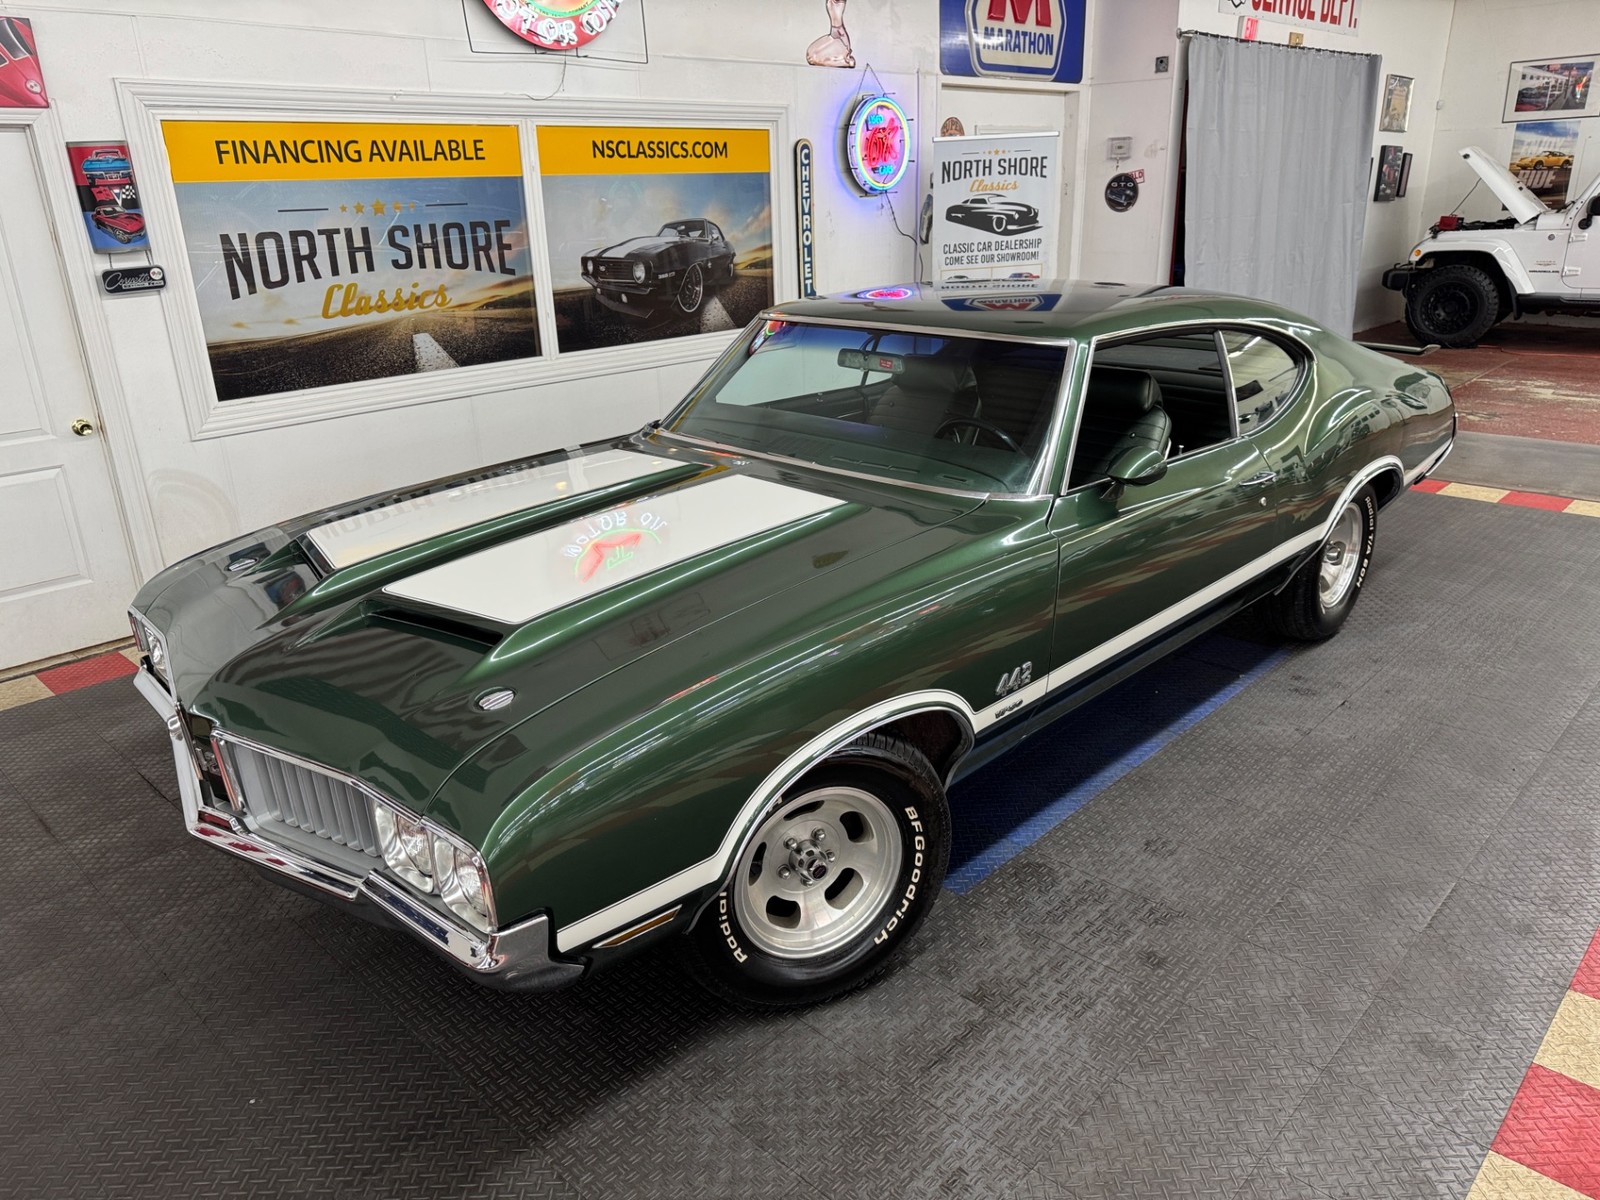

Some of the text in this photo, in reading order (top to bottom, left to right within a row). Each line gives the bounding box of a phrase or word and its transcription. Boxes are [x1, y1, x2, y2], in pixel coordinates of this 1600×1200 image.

[983, 26, 1054, 56] MARATHON
[214, 139, 486, 165] FINANCING AVAILABLE
[592, 140, 728, 160] NSCLASSICS.COM
[942, 156, 1048, 184] NORTH SHORE
[970, 179, 1019, 192] Classics
[801, 148, 813, 294] CHEVROLET
[219, 219, 516, 300] NORTH SHORE
[943, 238, 1042, 254] CLASSIC CAR DEALERSHIP
[945, 251, 1040, 265] COME SEE OUR SHOWROOM!
[321, 282, 452, 319] Classics
[1365, 496, 1375, 531] Radial
[995, 660, 1033, 697] 442
[873, 806, 925, 946] BFGoodrich
[718, 892, 748, 963] Radial
